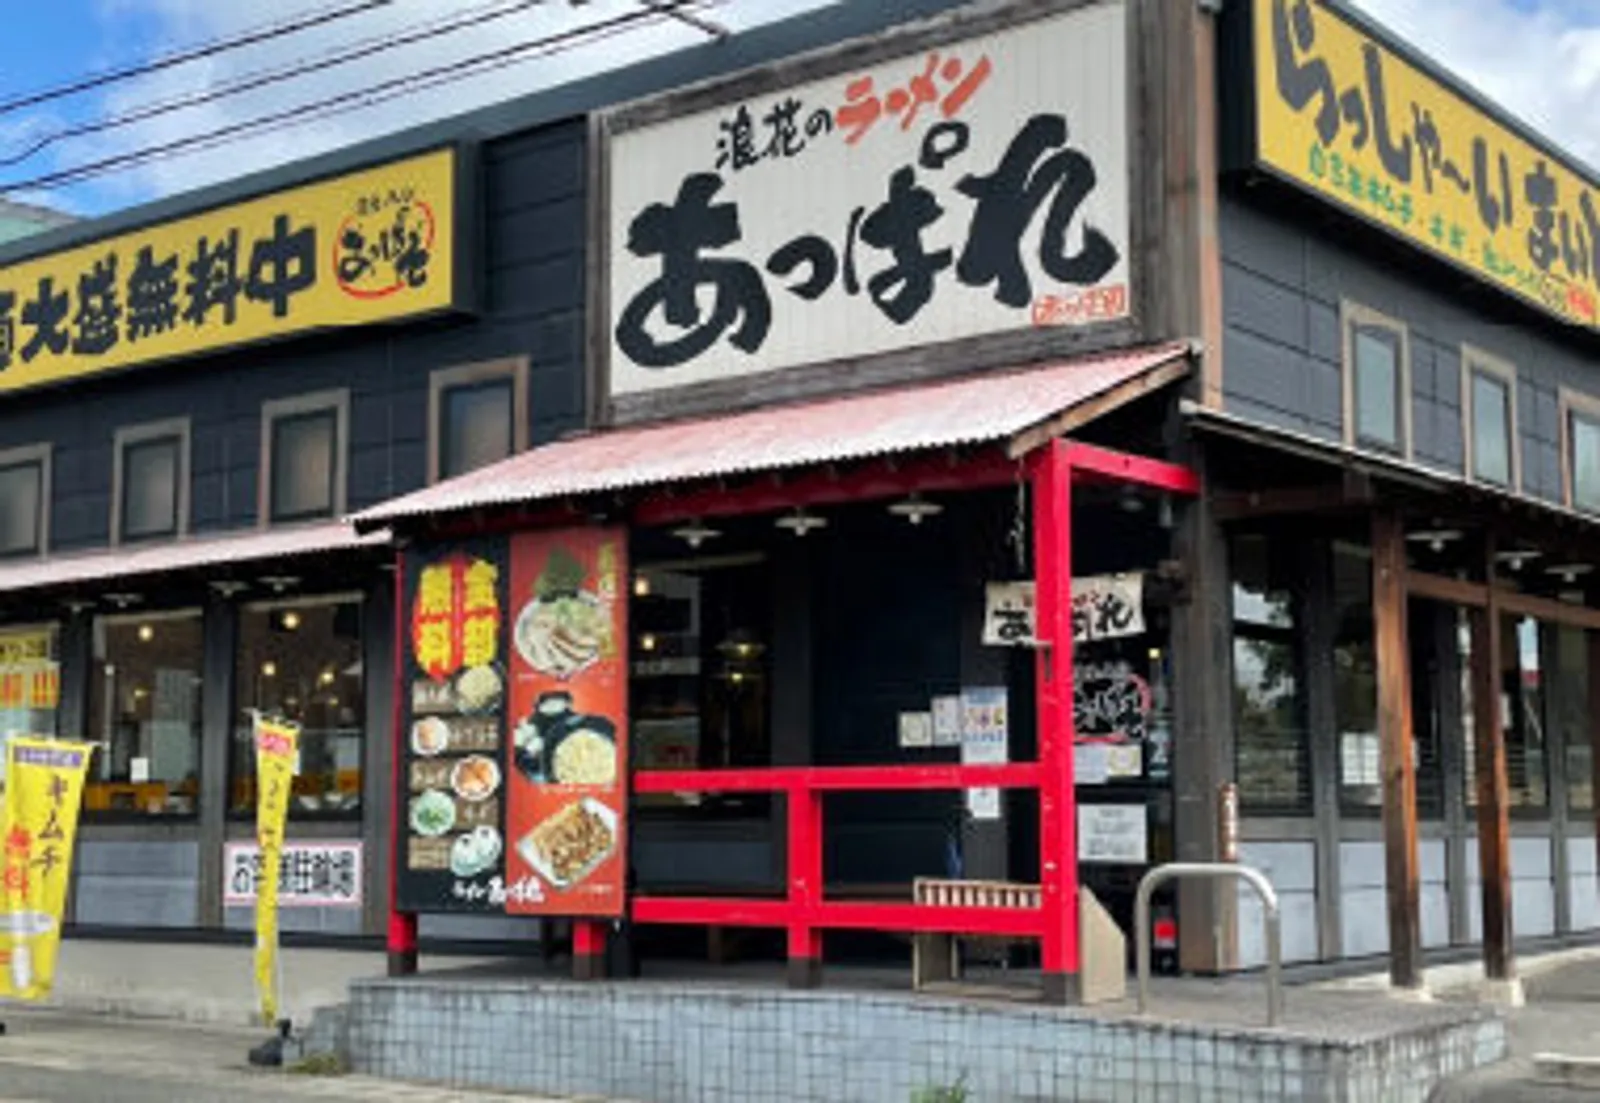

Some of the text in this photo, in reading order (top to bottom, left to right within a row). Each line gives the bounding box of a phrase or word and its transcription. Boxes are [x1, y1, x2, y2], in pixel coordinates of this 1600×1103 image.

[615, 113, 1120, 368] あっぱれ
[29, 775, 68, 878] キムチ
